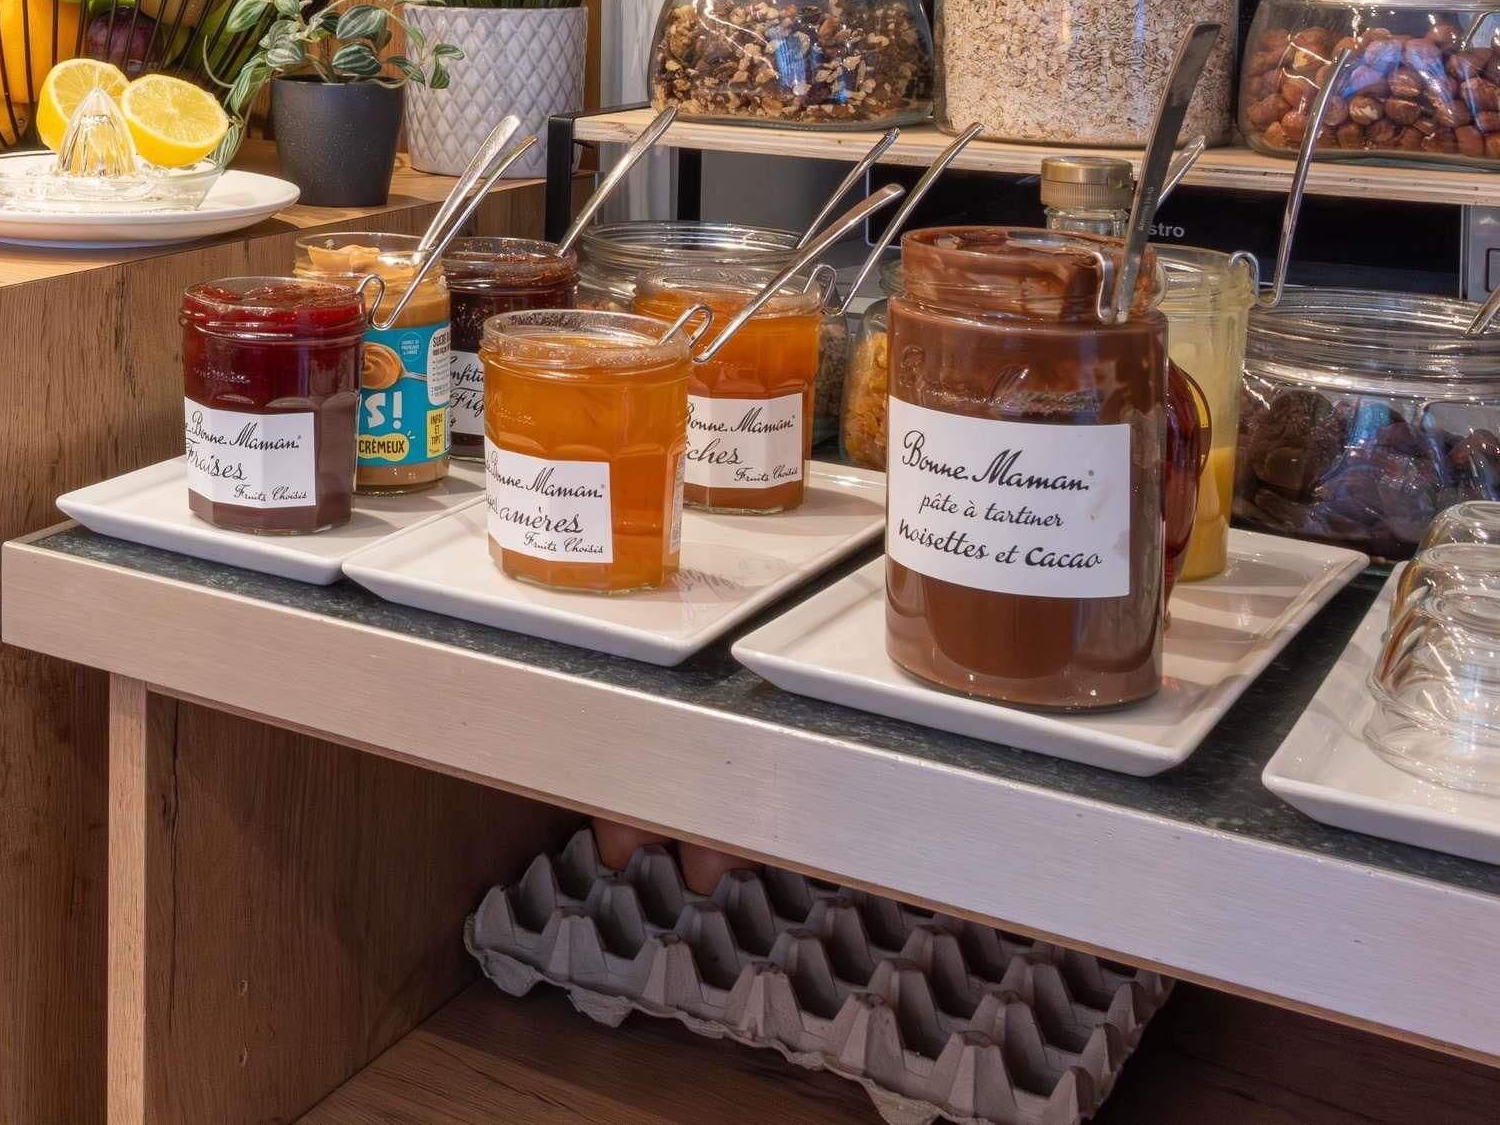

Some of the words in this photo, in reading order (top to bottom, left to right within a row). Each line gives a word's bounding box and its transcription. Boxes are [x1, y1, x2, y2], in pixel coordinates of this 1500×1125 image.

[192, 410, 228, 445] Bonne
[902, 430, 968, 480] Bonne
[733, 467, 770, 482] Fruits
[772, 464, 798, 480] Choisis
[233, 484, 267, 502] Fruits
[271, 485, 308, 501] Choisis
[499, 506, 584, 534] amères
[918, 492, 958, 515] pâte
[963, 500, 977, 518] à
[984, 502, 1064, 527] tartiner
[523, 531, 558, 553] Fruits
[563, 537, 604, 554] Choisis
[995, 545, 1017, 564] et
